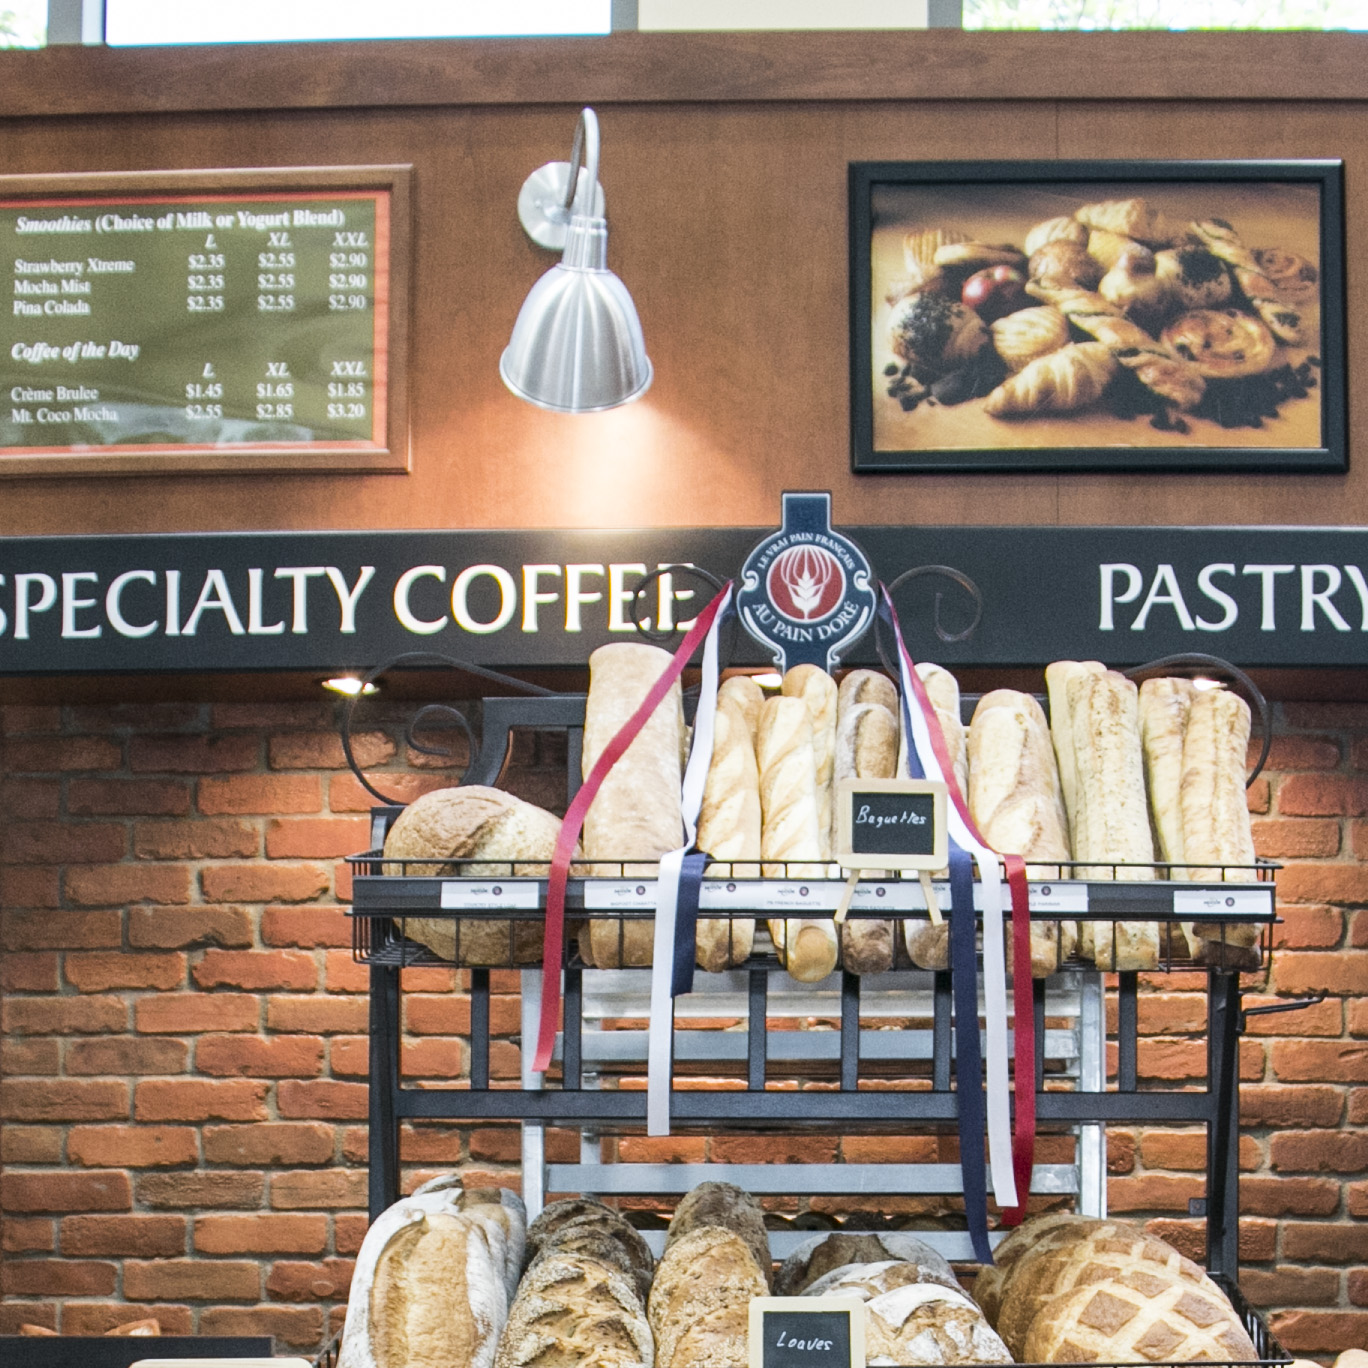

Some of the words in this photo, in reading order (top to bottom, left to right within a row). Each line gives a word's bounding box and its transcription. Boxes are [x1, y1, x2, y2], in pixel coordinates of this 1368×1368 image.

[14, 215, 93, 235] Smoothies
[94, 213, 156, 234] (Choice
[155, 212, 175, 231] of
[174, 209, 214, 231] Milk
[214, 214, 236, 230] or
[236, 208, 291, 233] Yogurt
[291, 207, 346, 229] Blend)
[267, 231, 292, 248] XL
[332, 231, 369, 248] XXL
[13, 258, 84, 277] Strawberry
[86, 257, 136, 274] Xtreme
[187, 253, 226, 271] $2.35
[258, 252, 296, 269] $2.55
[329, 252, 368, 269] $2.90
[13, 279, 60, 296] Mocha
[60, 278, 92, 295] Mist
[187, 274, 225, 292] $2.35
[257, 273, 296, 290] $2.55
[328, 273, 368, 290] $2.90
[12, 299, 44, 317] Pina
[42, 299, 91, 316] Colada
[186, 295, 225, 313] $2.35
[257, 294, 295, 312] $2.55
[328, 294, 367, 310] $2.90
[10, 341, 62, 365] Coffee
[61, 340, 81, 364] of
[79, 340, 107, 360] the
[107, 340, 141, 362] Day
[265, 361, 290, 378] XL
[330, 360, 367, 378] XXL
[9, 386, 55, 404] Crème
[56, 384, 99, 403] Brulee
[185, 382, 224, 400] $1.45
[256, 382, 294, 399] $1.65
[327, 382, 365, 399] $1.85
[11, 408, 35, 424] Mt.
[35, 407, 73, 424] Coco
[73, 405, 120, 423] Mocha
[184, 404, 222, 422] $2.55
[256, 403, 294, 420] $2.85
[327, 403, 366, 420] $3.20
[757, 553, 768, 569] LE
[766, 537, 789, 558] VRAI
[789, 531, 814, 542] PAIN
[815, 533, 855, 570] FRANÇAIS
[393, 560, 698, 635] COFFEE
[752, 602, 774, 624] AU
[772, 621, 813, 642] PAIN
[816, 600, 859, 640] DORÉ
[855, 804, 927, 828] Baguettes
[776, 1330, 834, 1351] Loaves
